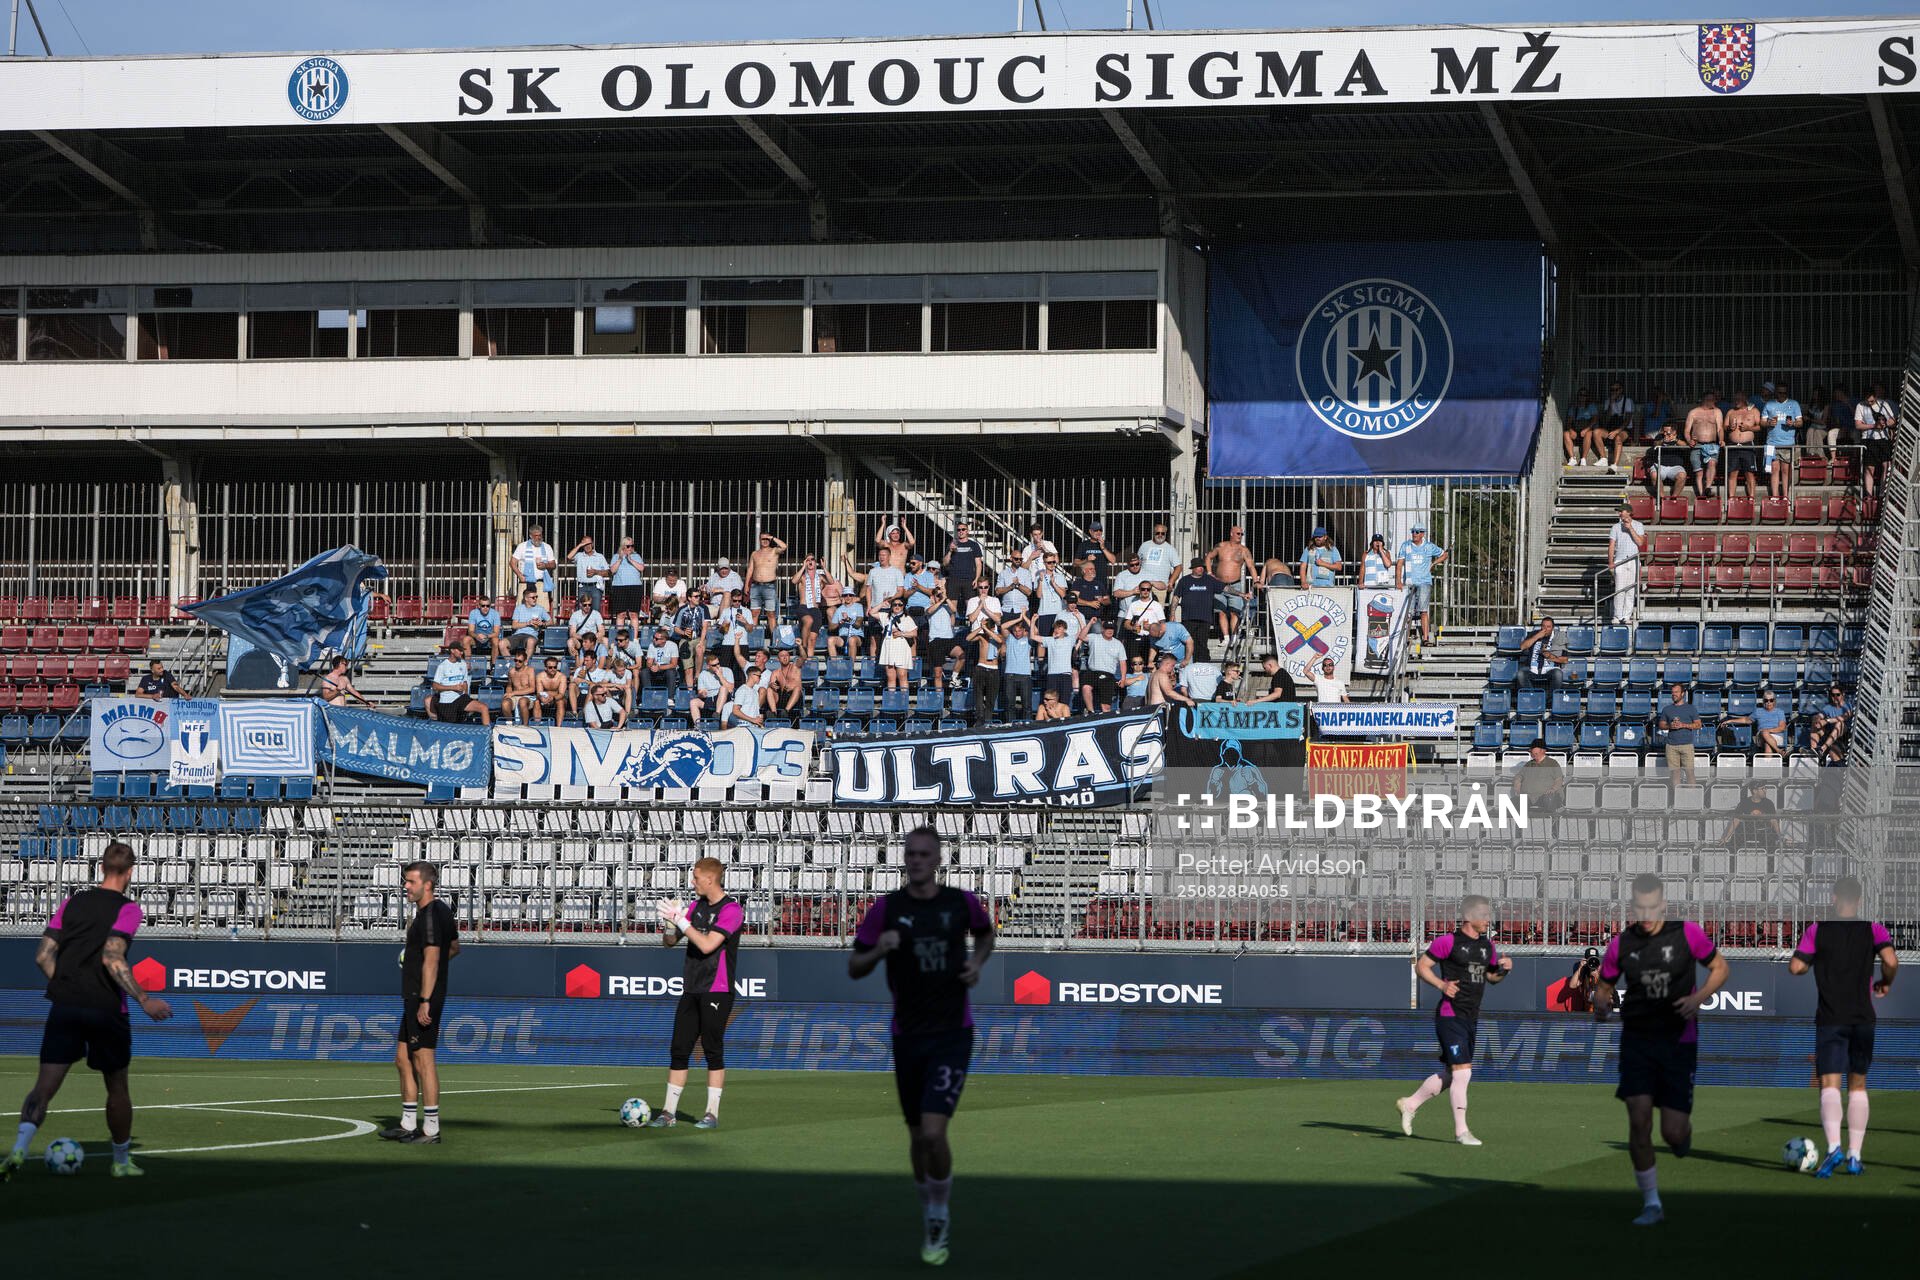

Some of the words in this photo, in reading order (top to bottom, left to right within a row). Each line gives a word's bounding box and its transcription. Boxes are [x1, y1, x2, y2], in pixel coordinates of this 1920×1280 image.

[296, 63, 309, 76] SK
[309, 59, 339, 74] SIGMA
[1878, 36, 1917, 86] S
[458, 67, 561, 116] SK
[600, 55, 1046, 112] OLOMOUC
[1095, 49, 1388, 102] SIGMA
[1430, 31, 1562, 95] MŽ
[295, 102, 342, 119] OLOMOUC
[1321, 295, 1351, 323] SK
[1353, 286, 1427, 323] SIGMA
[1319, 393, 1431, 432] OLOMOUC
[1314, 711, 1440, 727] SNAPPHANEKLANEN
[172, 761, 215, 776] Framtid
[834, 717, 1166, 802] ULTRAS
[1313, 747, 1403, 771] SKÅNELAGET
[1324, 773, 1382, 798] EUROPA
[173, 968, 326, 990] REDSTONE
[608, 976, 767, 997] REDSNE
[1059, 982, 1222, 1004] REDSTONE
[265, 1002, 543, 1060] Tipsort
[1254, 1016, 1386, 1068] SIG
